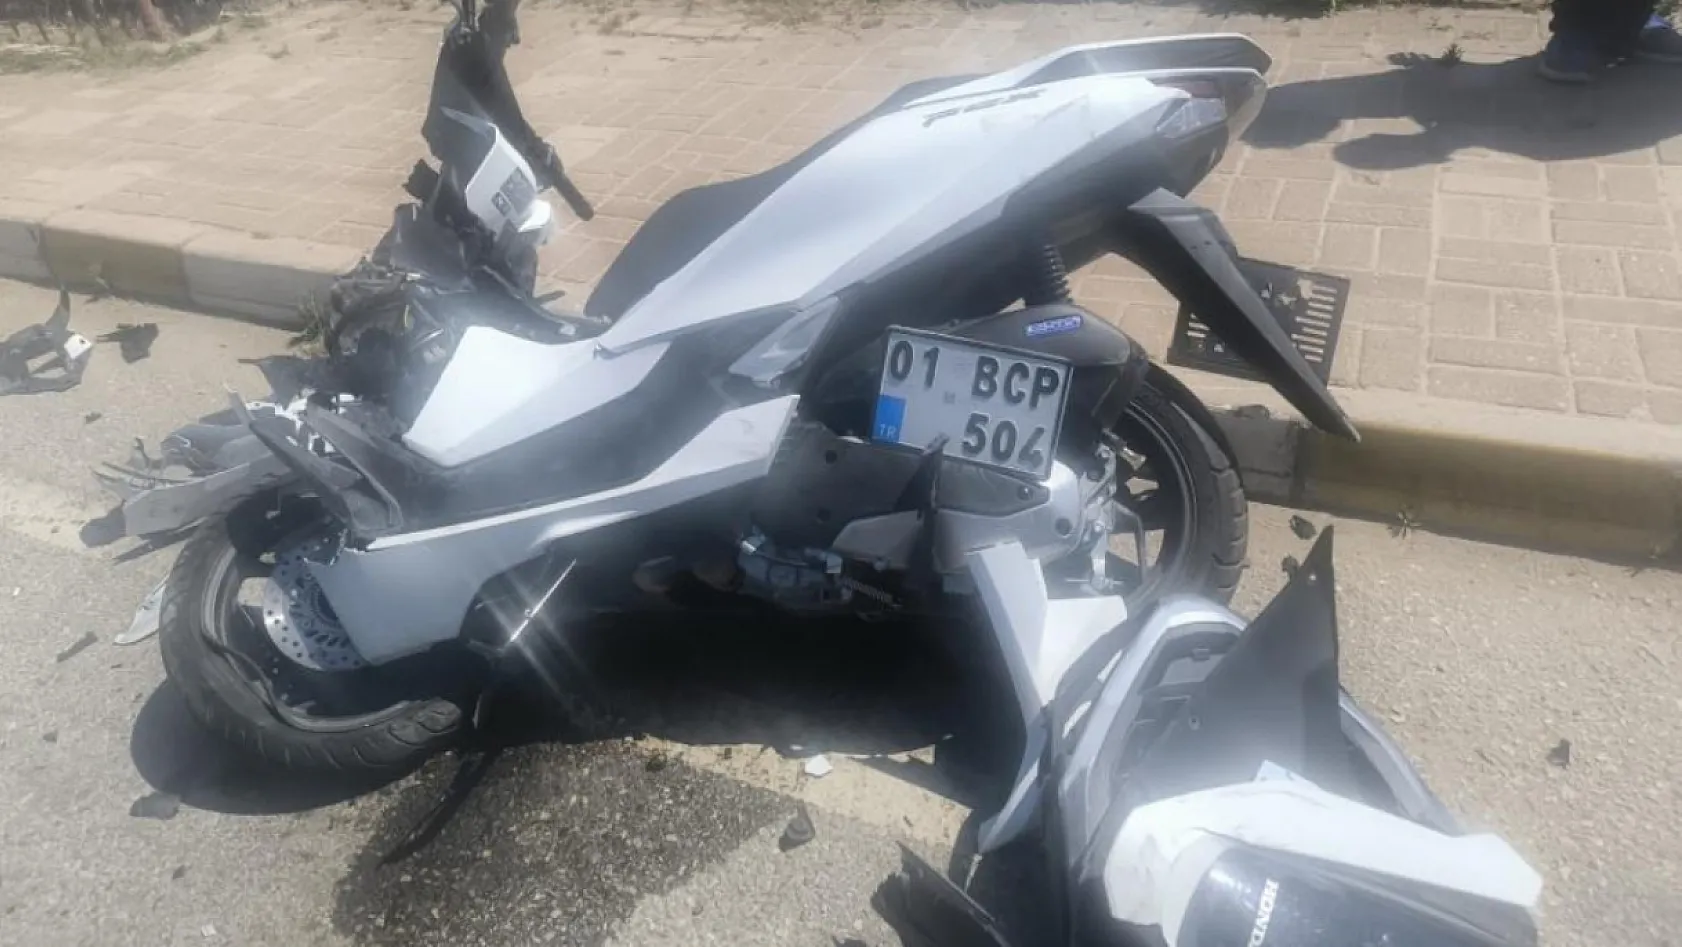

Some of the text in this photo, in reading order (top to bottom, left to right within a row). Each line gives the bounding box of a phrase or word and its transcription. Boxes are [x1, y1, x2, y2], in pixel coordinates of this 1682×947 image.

[890, 340, 1059, 410] 01 BCP
[879, 423, 896, 437] TR
[962, 412, 1045, 467] 504
[1247, 878, 1280, 947] HOND
